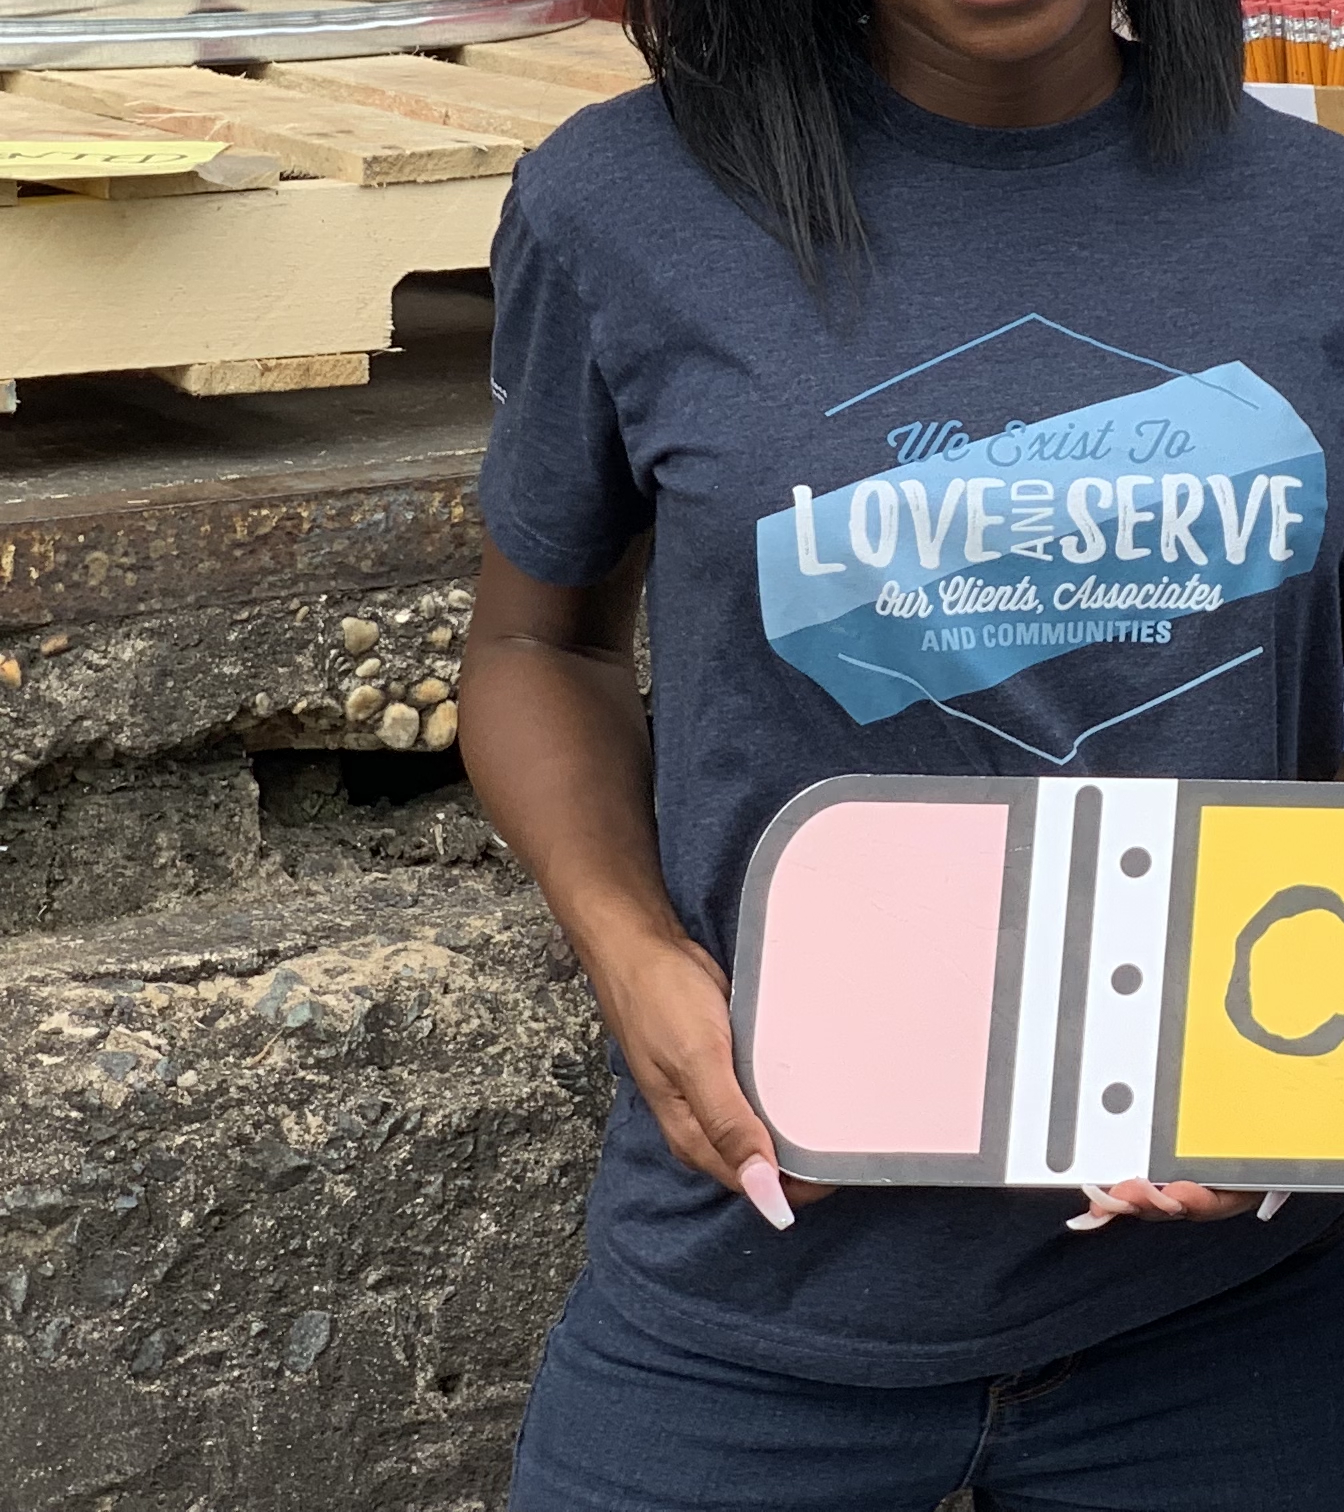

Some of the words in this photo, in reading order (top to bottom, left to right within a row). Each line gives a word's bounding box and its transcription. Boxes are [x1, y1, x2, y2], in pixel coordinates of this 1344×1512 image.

[887, 420, 970, 463] We
[986, 420, 1115, 467] Exist
[1129, 419, 1195, 464] To
[792, 478, 1005, 576] LOVE
[1010, 479, 1055, 561] AND
[1060, 473, 1303, 566] SERVE
[875, 579, 933, 619] Our
[938, 575, 1044, 616] Clients,
[1053, 573, 1225, 613] Associates
[921, 627, 976, 652] AND
[982, 620, 1172, 648] COMMUNITIES
